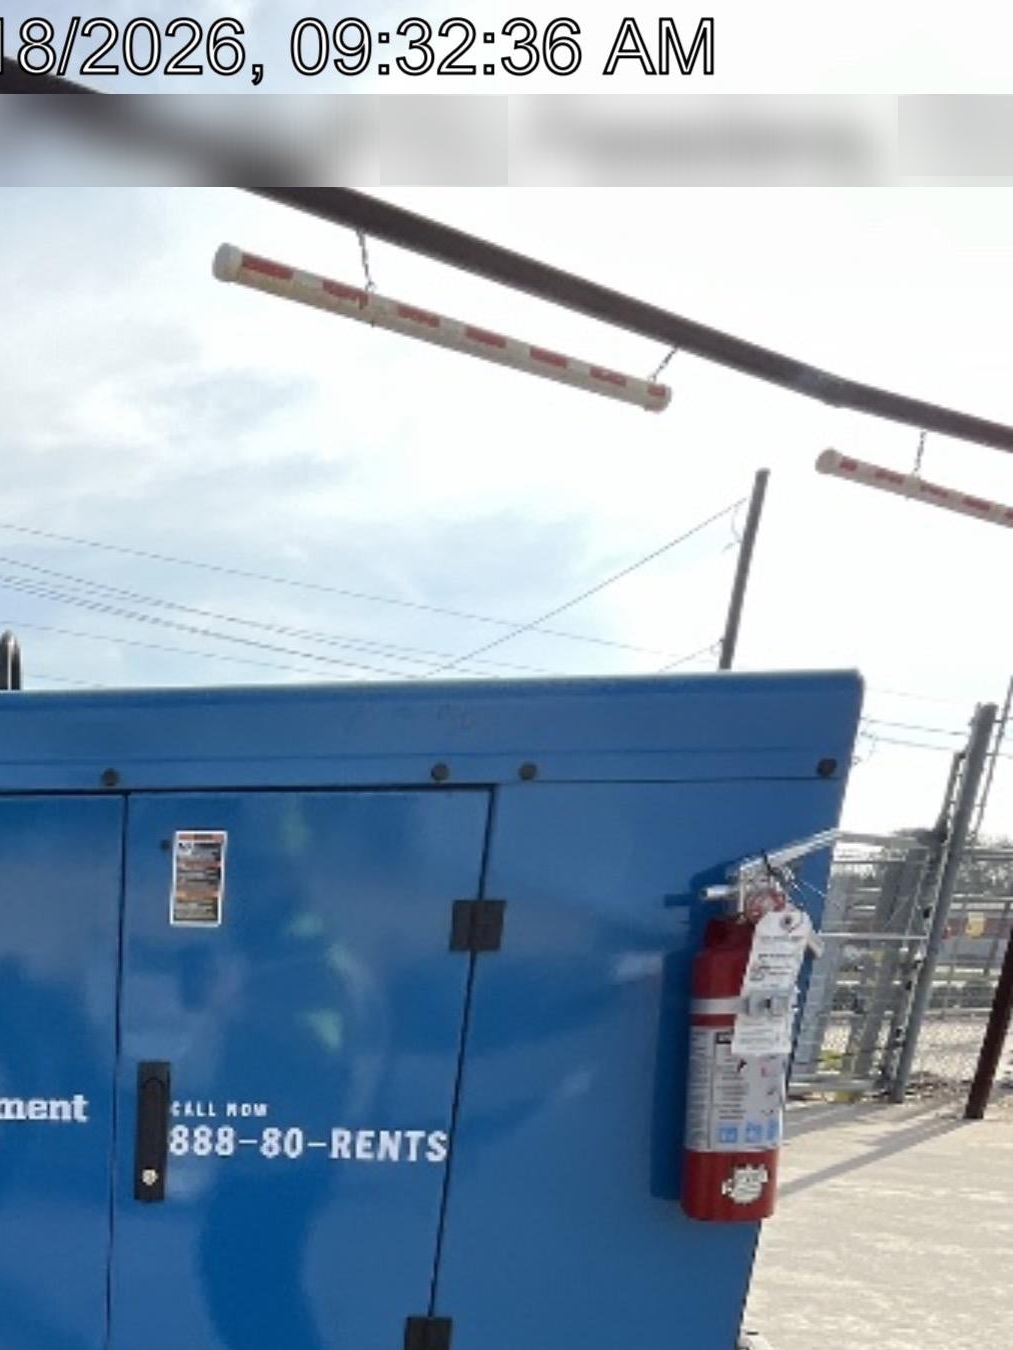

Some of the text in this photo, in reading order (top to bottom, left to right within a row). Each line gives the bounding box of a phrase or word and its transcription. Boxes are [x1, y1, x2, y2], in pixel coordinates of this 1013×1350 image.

[170, 1100, 268, 1118] CALL NOW
[169, 1124, 449, 1163] 888-80-RENTS
